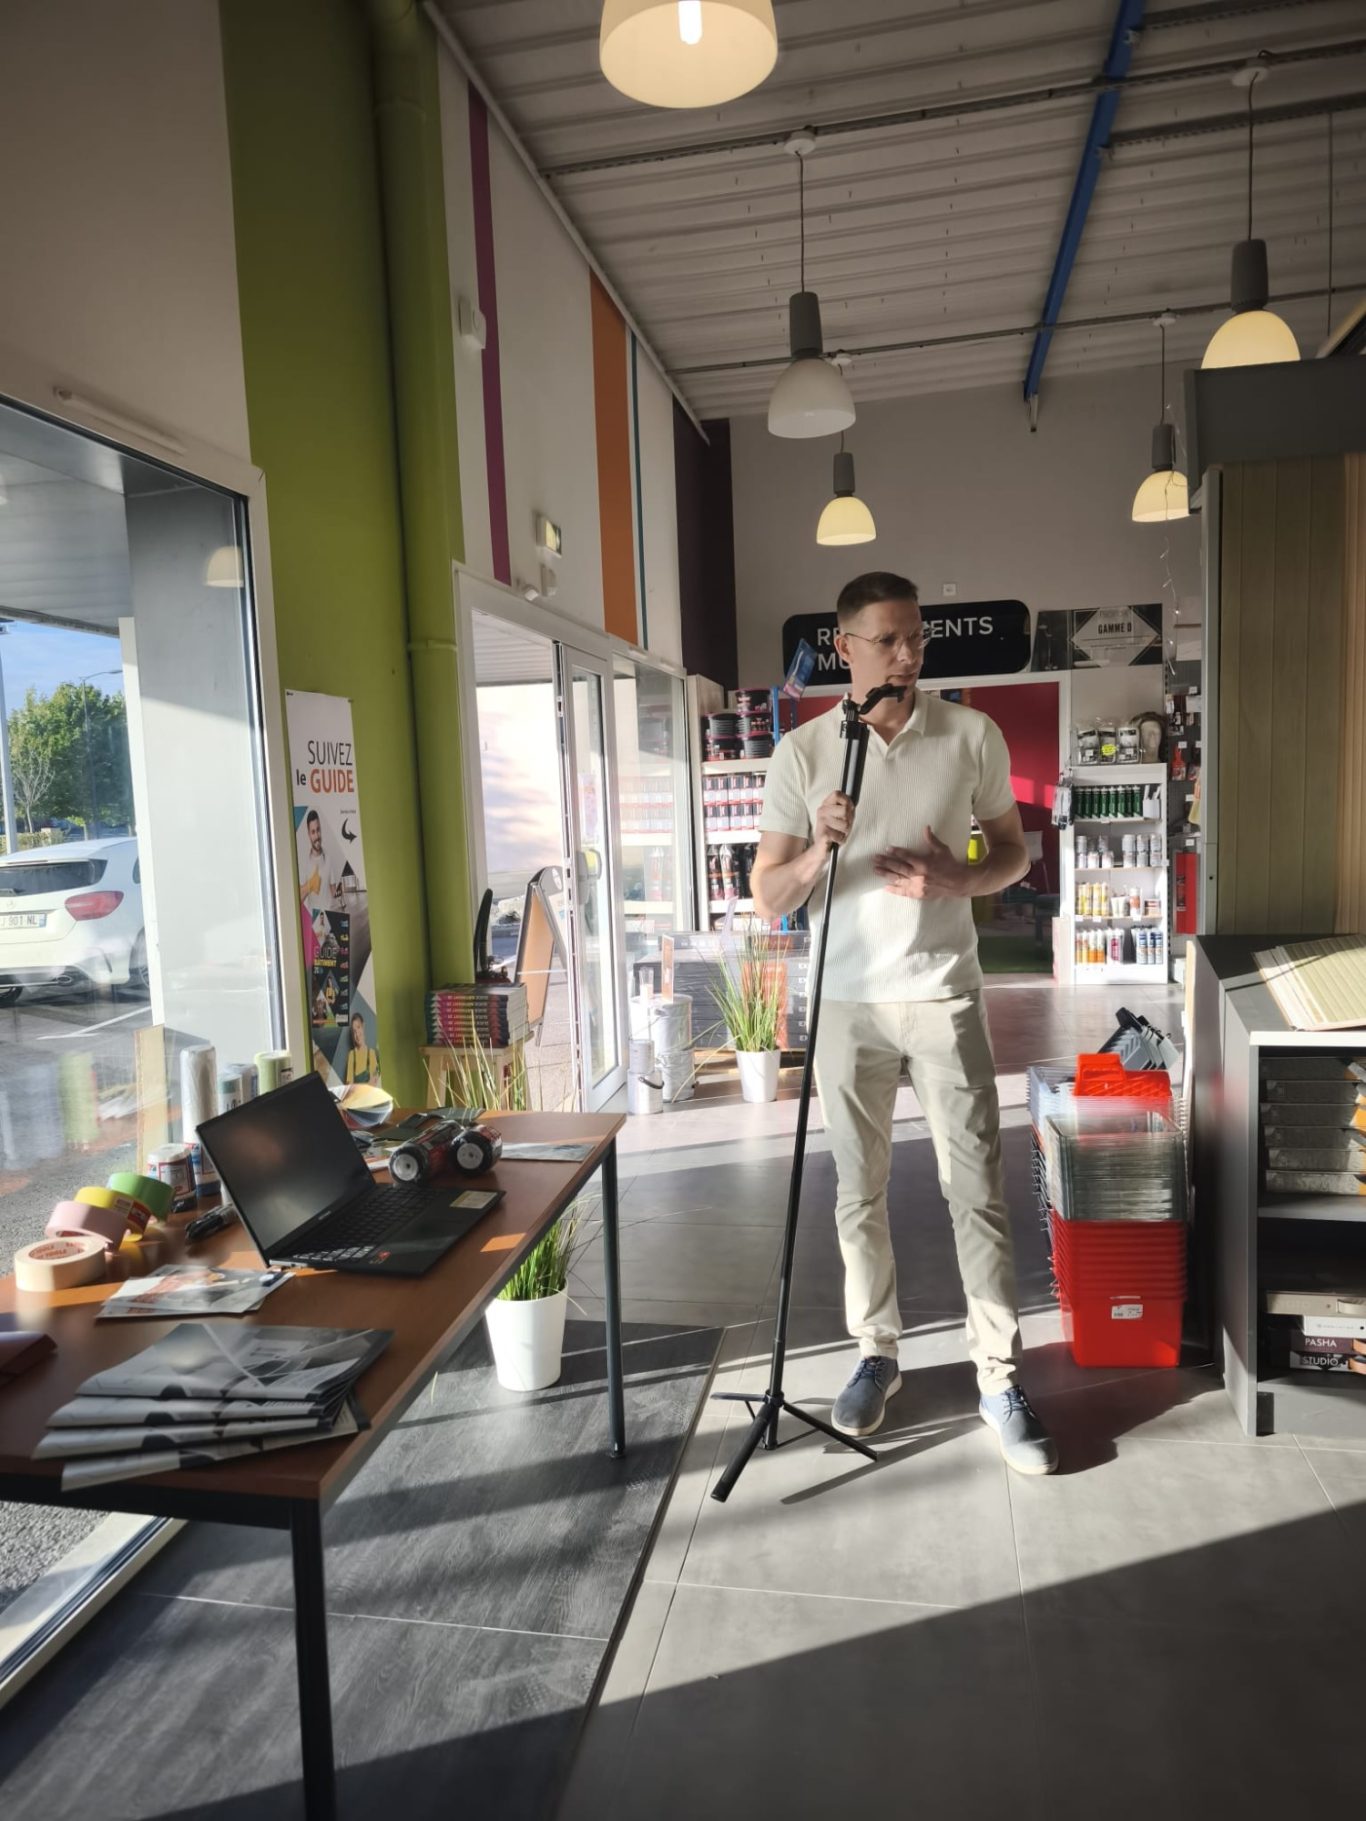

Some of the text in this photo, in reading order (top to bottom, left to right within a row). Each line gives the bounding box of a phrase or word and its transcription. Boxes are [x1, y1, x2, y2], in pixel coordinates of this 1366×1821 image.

[308, 740, 353, 766] SUIVEZ
[296, 768, 355, 793] le GUIDE
[1305, 1338, 1337, 1348] PASHA
[1302, 1355, 1339, 1367] STUDIO
